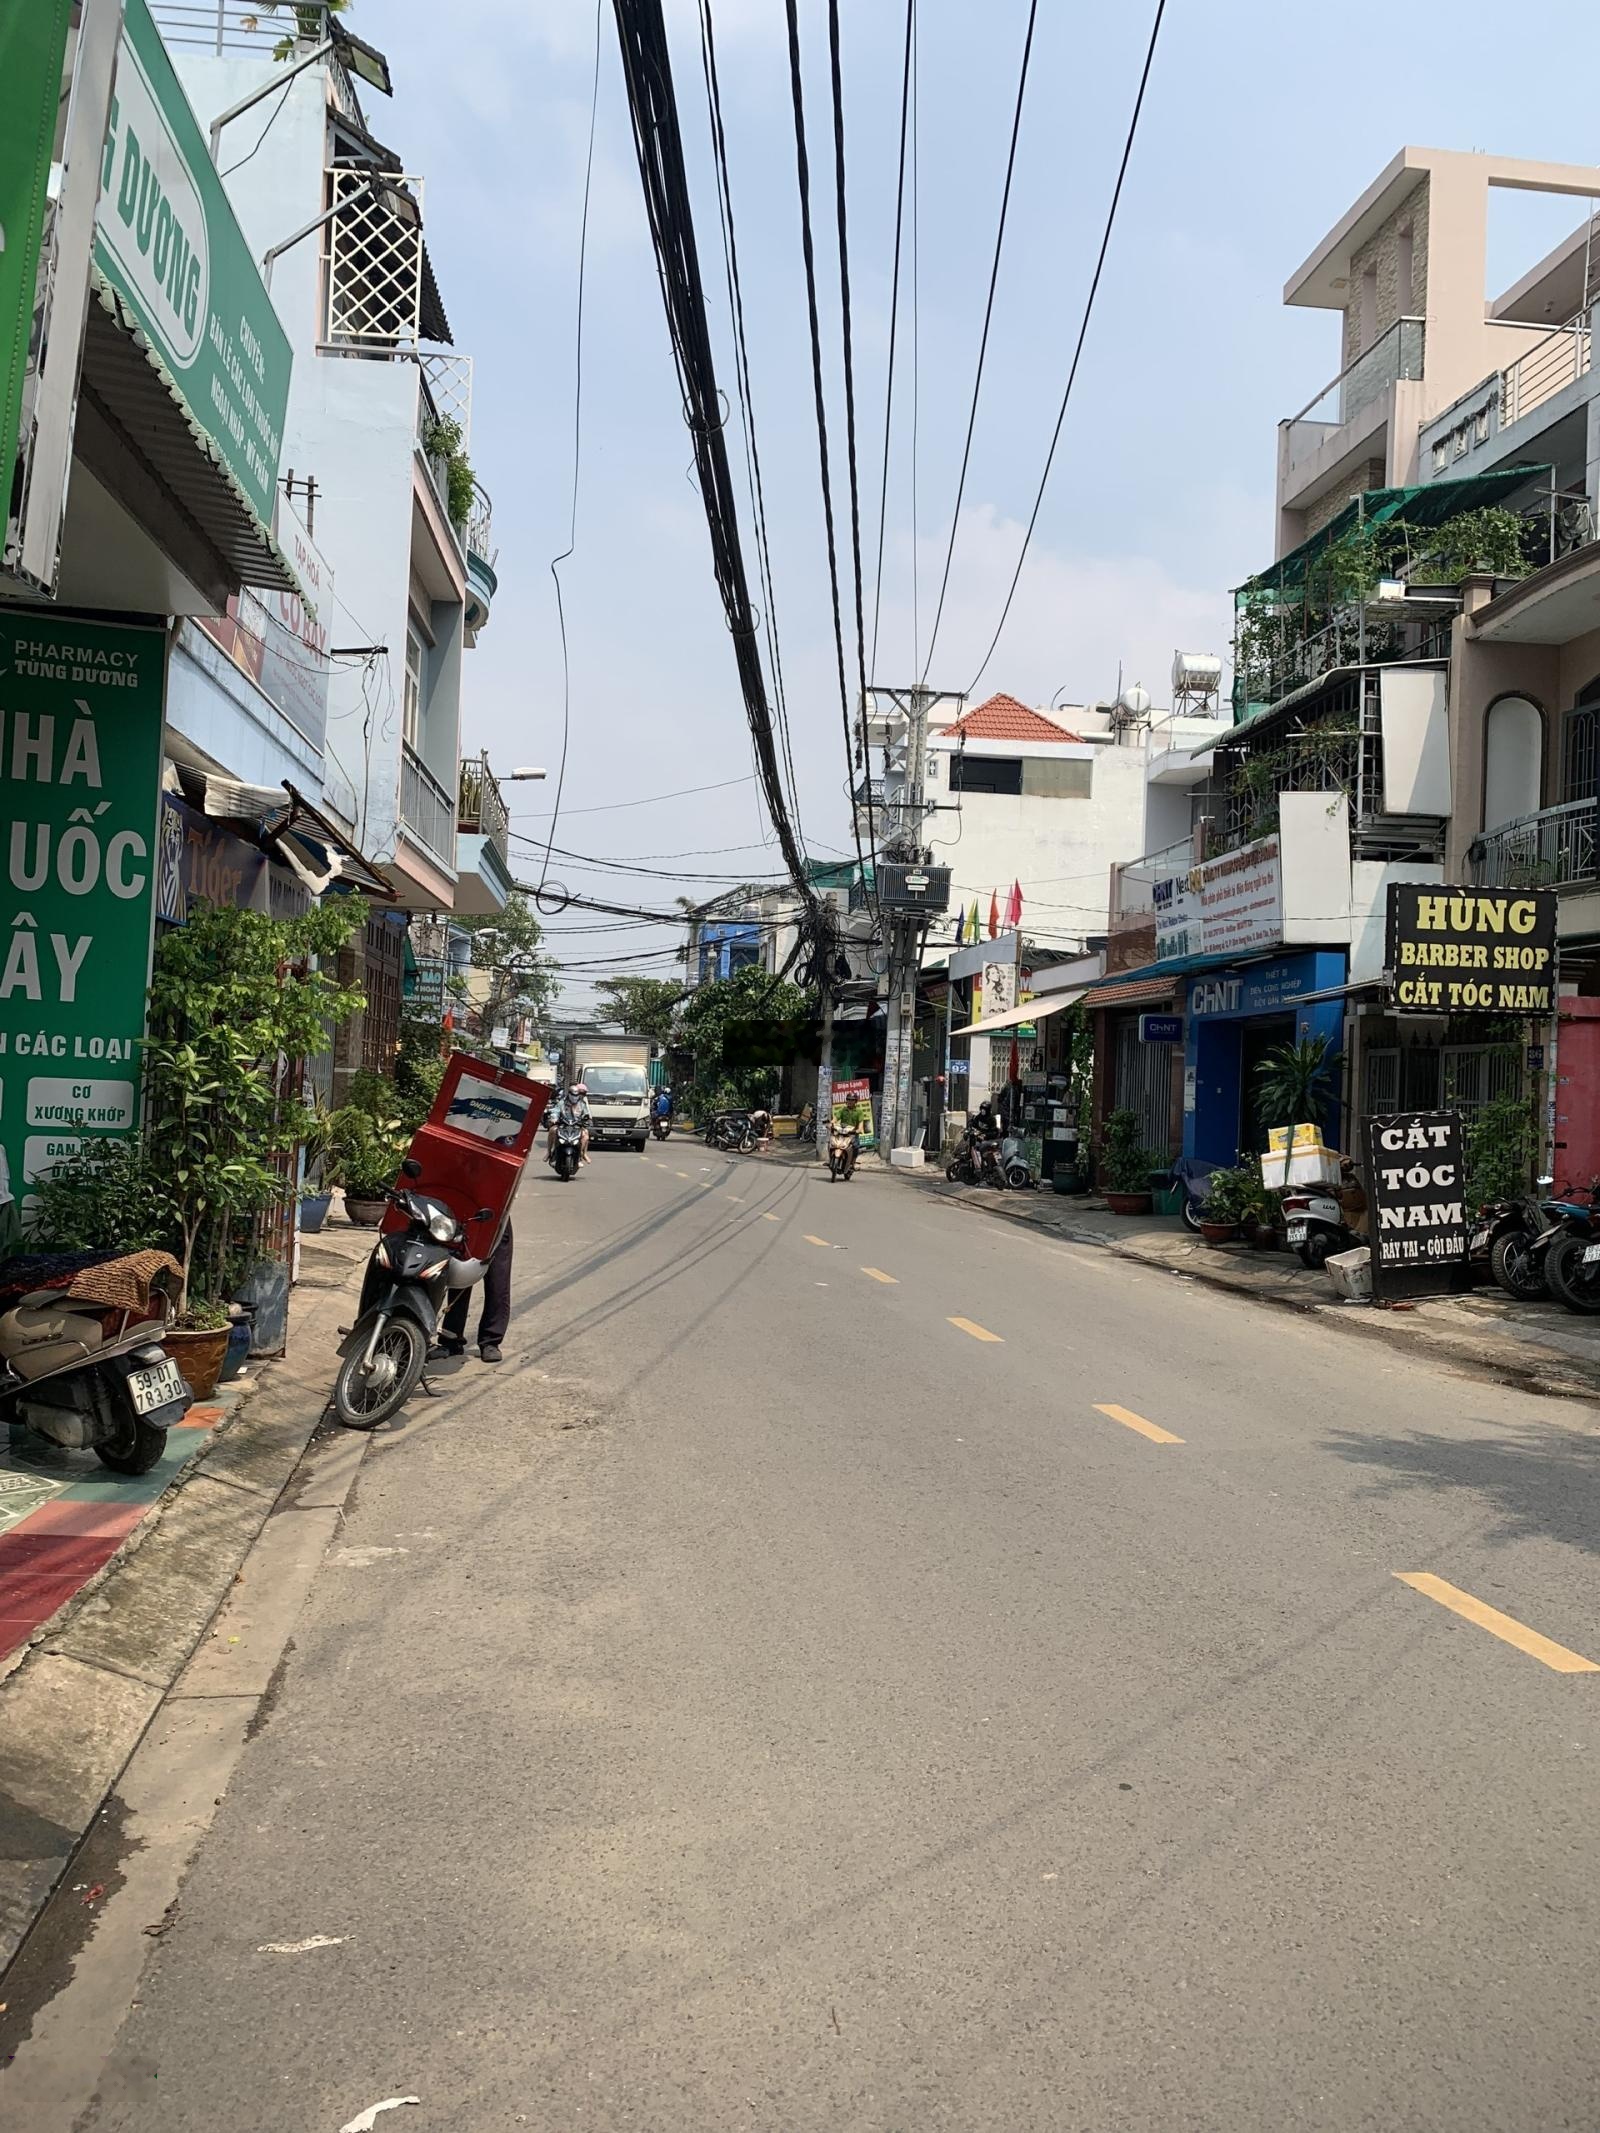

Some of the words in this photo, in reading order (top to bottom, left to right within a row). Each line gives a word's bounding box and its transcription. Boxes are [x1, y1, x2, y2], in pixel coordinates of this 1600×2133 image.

[117, 122, 201, 342] DƯƠNG
[208, 311, 225, 356] BÁN
[229, 354, 244, 393] CÁC
[241, 375, 256, 419] LOẠI
[210, 372, 231, 426] NGOẠI
[227, 405, 246, 450] NHẬP
[15, 639, 139, 668] PHARMACY
[15, 658, 67, 680] TÙNG
[71, 666, 138, 688] DƯƠNG
[0, 698, 103, 788] HÀ
[187, 825, 243, 909] Tiger
[1416, 889, 1537, 934] HÙNG
[1400, 942, 1488, 968] BARBER
[1493, 946, 1550, 971] SHOP
[1399, 971, 1443, 1005] CẮT
[1448, 977, 1493, 1007] TÓC
[1498, 984, 1550, 1009] NAM
[15, 1030, 67, 1057] CÁC
[74, 1035, 132, 1064] LOẠI
[951, 1064, 967, 1073] 92
[72, 1085, 92, 1099] CƠ
[34, 1105, 84, 1121] XƯƠNG
[88, 1105, 126, 1122] KHỚP
[46, 1142, 76, 1157] GAN
[1380, 1118, 1451, 1151] CẮT
[1381, 1161, 1456, 1190] TÓC
[1379, 1202, 1463, 1230] NAM
[1382, 1238, 1401, 1260] RÁY
[1402, 1240, 1419, 1258] TAI
[1427, 1234, 1444, 1259] GỘI
[1445, 1230, 1465, 1255] ĐẦU
[135, 1364, 172, 1392] 59-D1
[135, 1379, 182, 1411] 783.30
